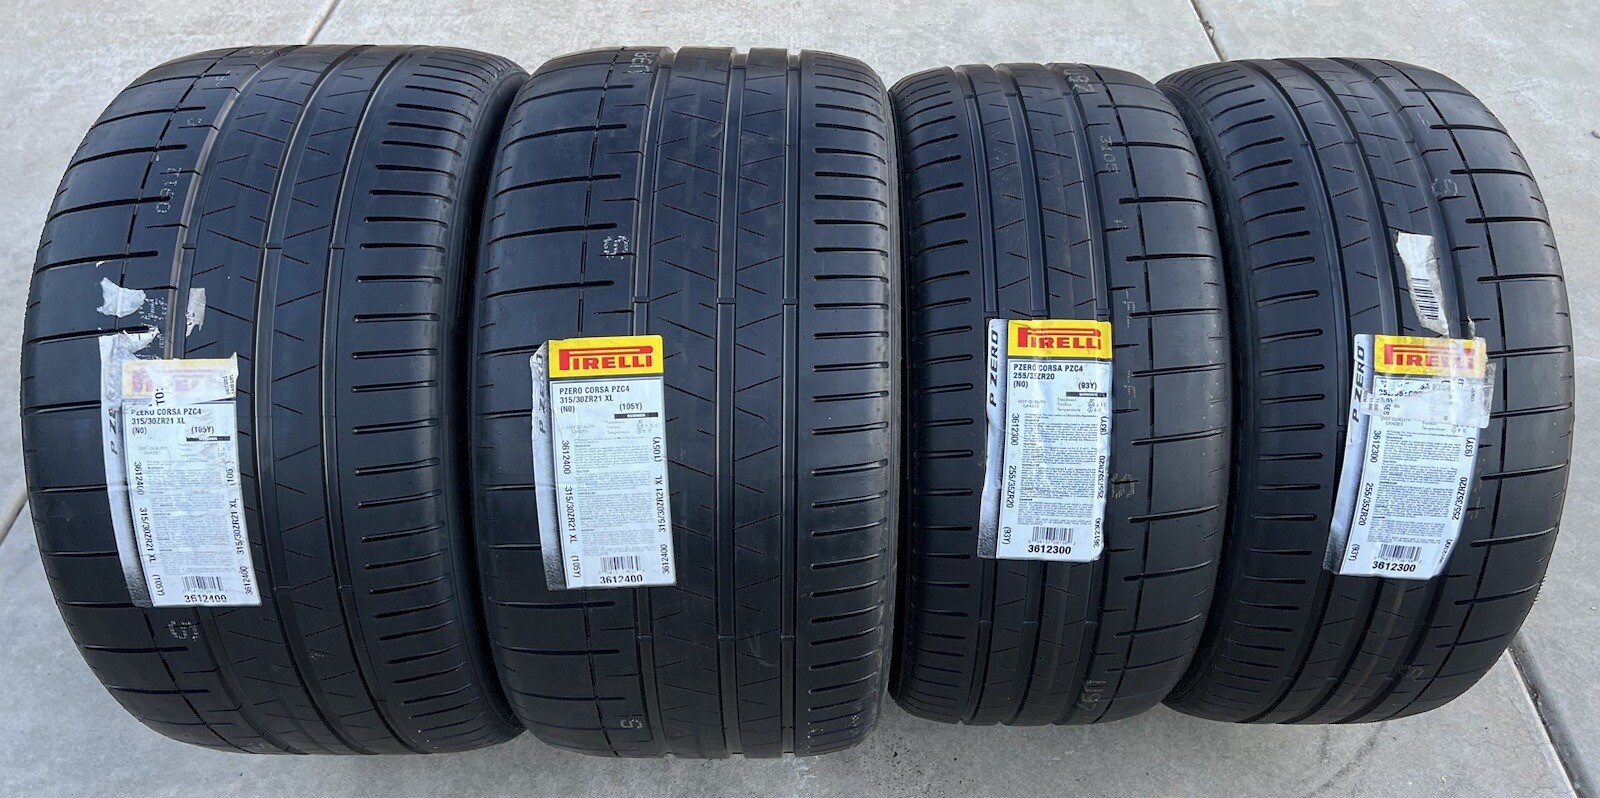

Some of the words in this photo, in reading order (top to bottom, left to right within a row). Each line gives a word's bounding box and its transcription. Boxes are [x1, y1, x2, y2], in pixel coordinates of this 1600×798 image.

[1017, 327, 1102, 350] PIRELLI
[558, 345, 654, 371] PIRELLI
[989, 329, 999, 388] ZERO
[1039, 364, 1063, 372] CORSA
[1013, 372, 1055, 380] 255/35ZR20
[1078, 382, 1098, 390] (93Y)
[1354, 346, 1365, 403] ZERO
[559, 387, 583, 395] PZERO
[584, 386, 609, 394] CORSA
[611, 385, 630, 393] PZC4
[559, 396, 602, 404] 315/30ZR21
[989, 393, 998, 408] P
[156, 408, 181, 416] CORSA
[183, 407, 202, 416] PZC4
[619, 402, 643, 411] (105Y)
[1352, 409, 1360, 423] P
[131, 417, 175, 425] 315/30ZR21
[176, 417, 186, 425] XL
[191, 426, 215, 435] (105Y)
[1011, 413, 1020, 446] 3612300
[561, 440, 572, 475] 3612400
[652, 436, 662, 463] (105Y)
[1370, 430, 1382, 463] 3612300
[133, 461, 146, 496] 3612400
[225, 460, 235, 486] (105)
[655, 475, 664, 485] XL
[1451, 477, 1468, 521] 255/35ZR20
[1464, 437, 1476, 458] (93Y)
[1006, 465, 1017, 509] 255/35ZR20
[229, 498, 238, 508] XL
[564, 487, 576, 532] 315/30ZR21
[656, 488, 667, 533] 315/30ZR21
[1358, 482, 1374, 526] 255/35ZR20
[139, 507, 154, 552] 315/30ZR21
[231, 508, 245, 555] 315/30ZR21
[569, 534, 578, 543] XL
[149, 553, 157, 562] XL
[658, 544, 670, 574] 3612400
[1028, 545, 1072, 555] 3612300
[571, 555, 582, 578] (105Y)
[1372, 561, 1416, 572] 3612300
[152, 574, 165, 597] (105Y)
[239, 566, 254, 595] 3612400
[600, 574, 643, 584] 3612400
[184, 594, 227, 603] 3612400
